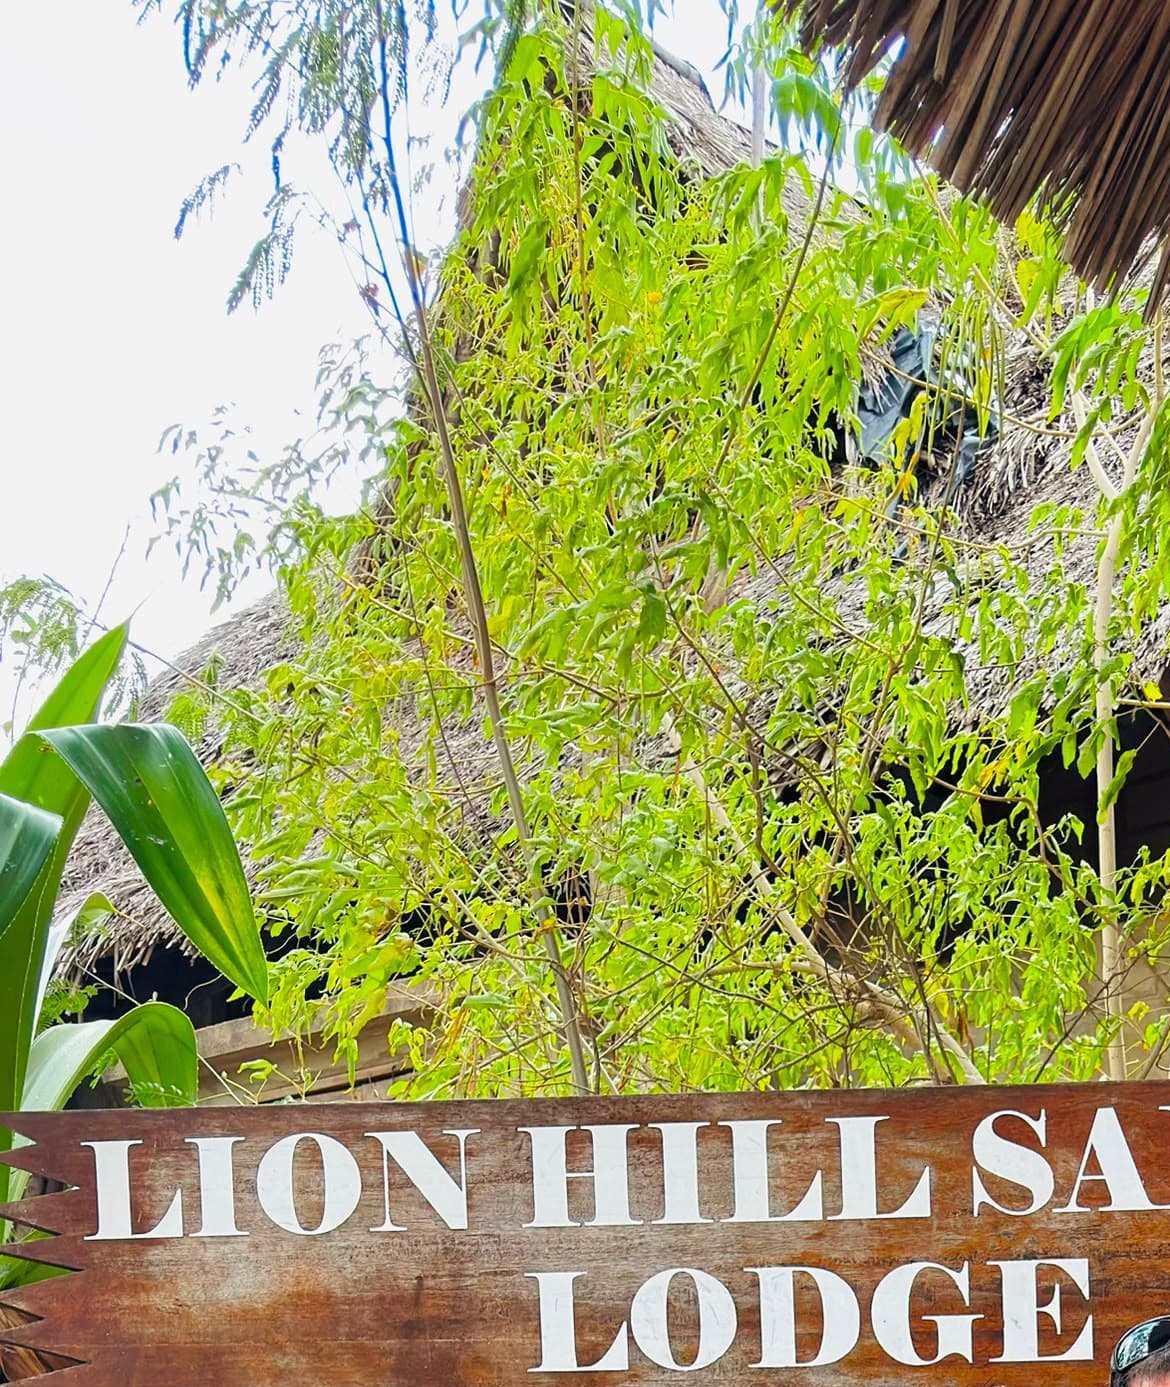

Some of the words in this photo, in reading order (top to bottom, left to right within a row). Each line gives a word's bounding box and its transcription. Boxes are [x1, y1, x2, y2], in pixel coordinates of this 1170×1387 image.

[80, 1127, 481, 1241] LION
[517, 1116, 931, 1229] HILL
[523, 1258, 1094, 1373] LODGE
